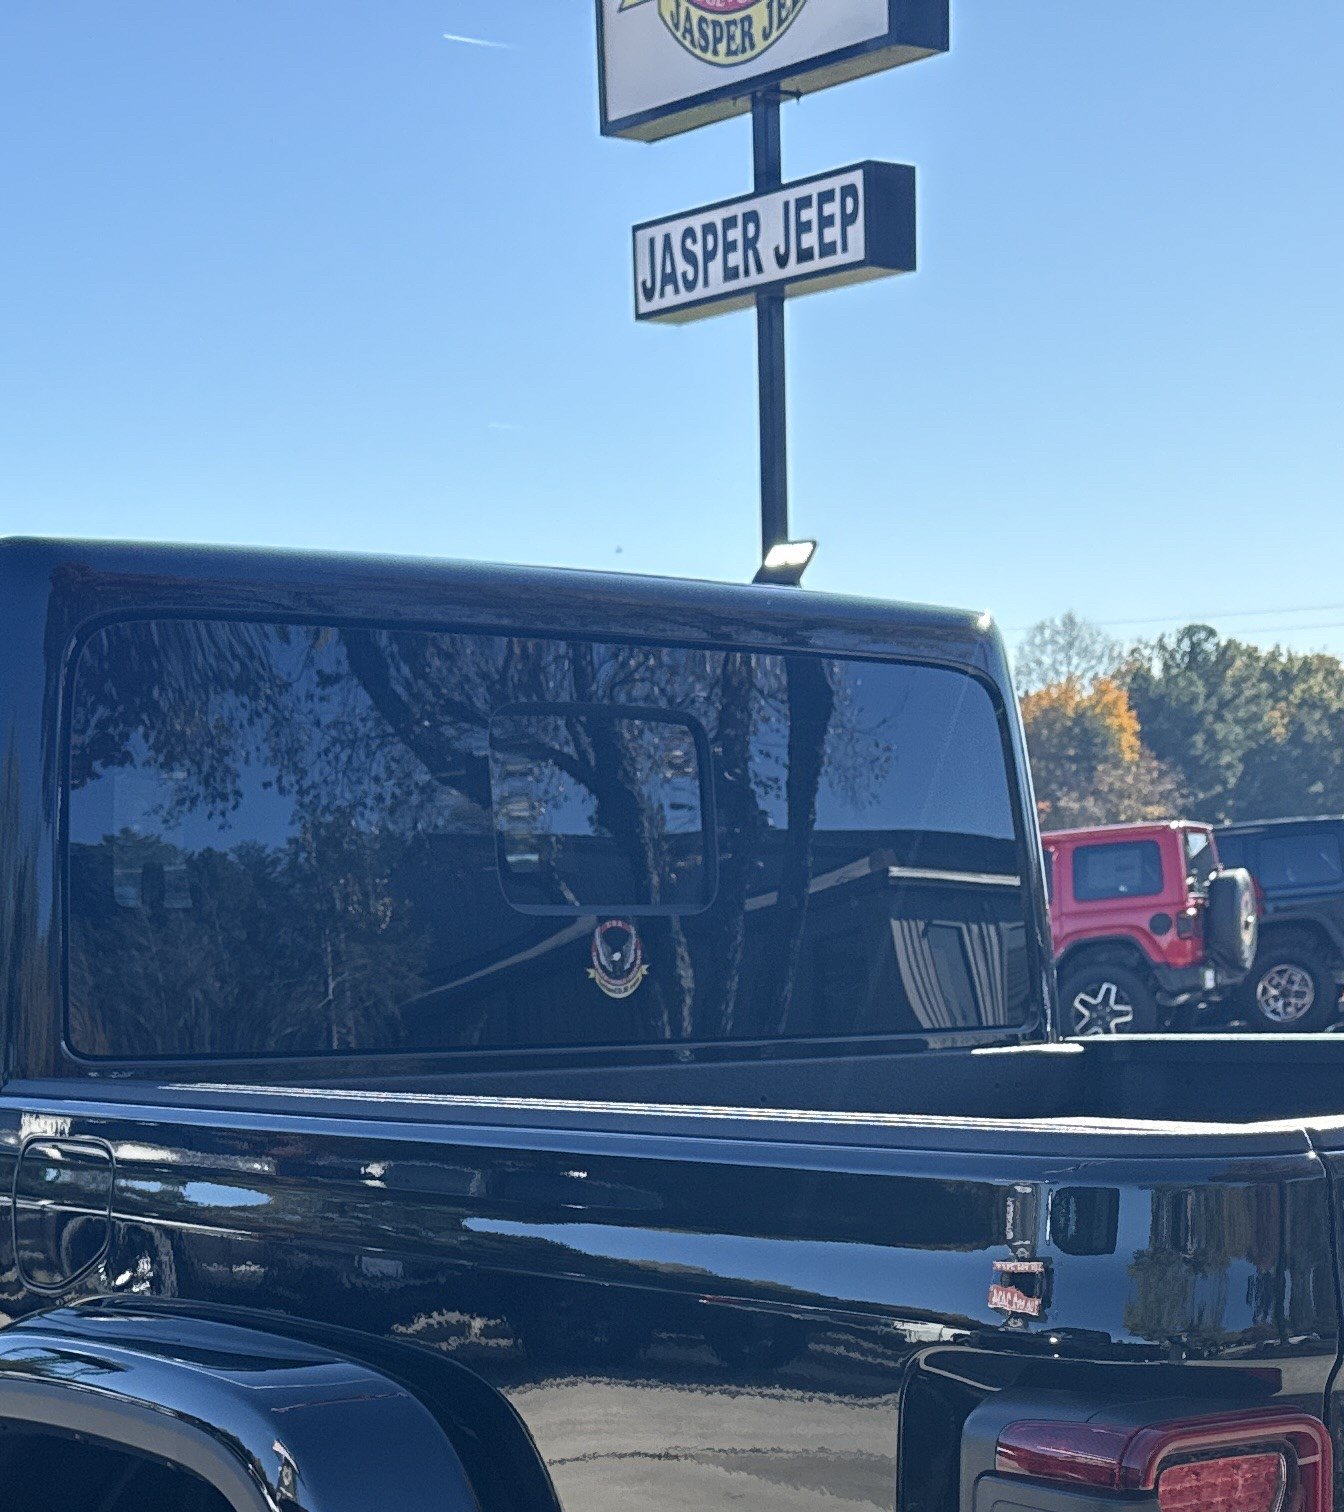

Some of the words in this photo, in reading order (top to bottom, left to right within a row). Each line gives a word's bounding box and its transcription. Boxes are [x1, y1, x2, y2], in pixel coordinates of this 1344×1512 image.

[670, 7, 755, 57] JASPER
[641, 209, 763, 303] JASPER
[774, 183, 860, 269] JEEP
